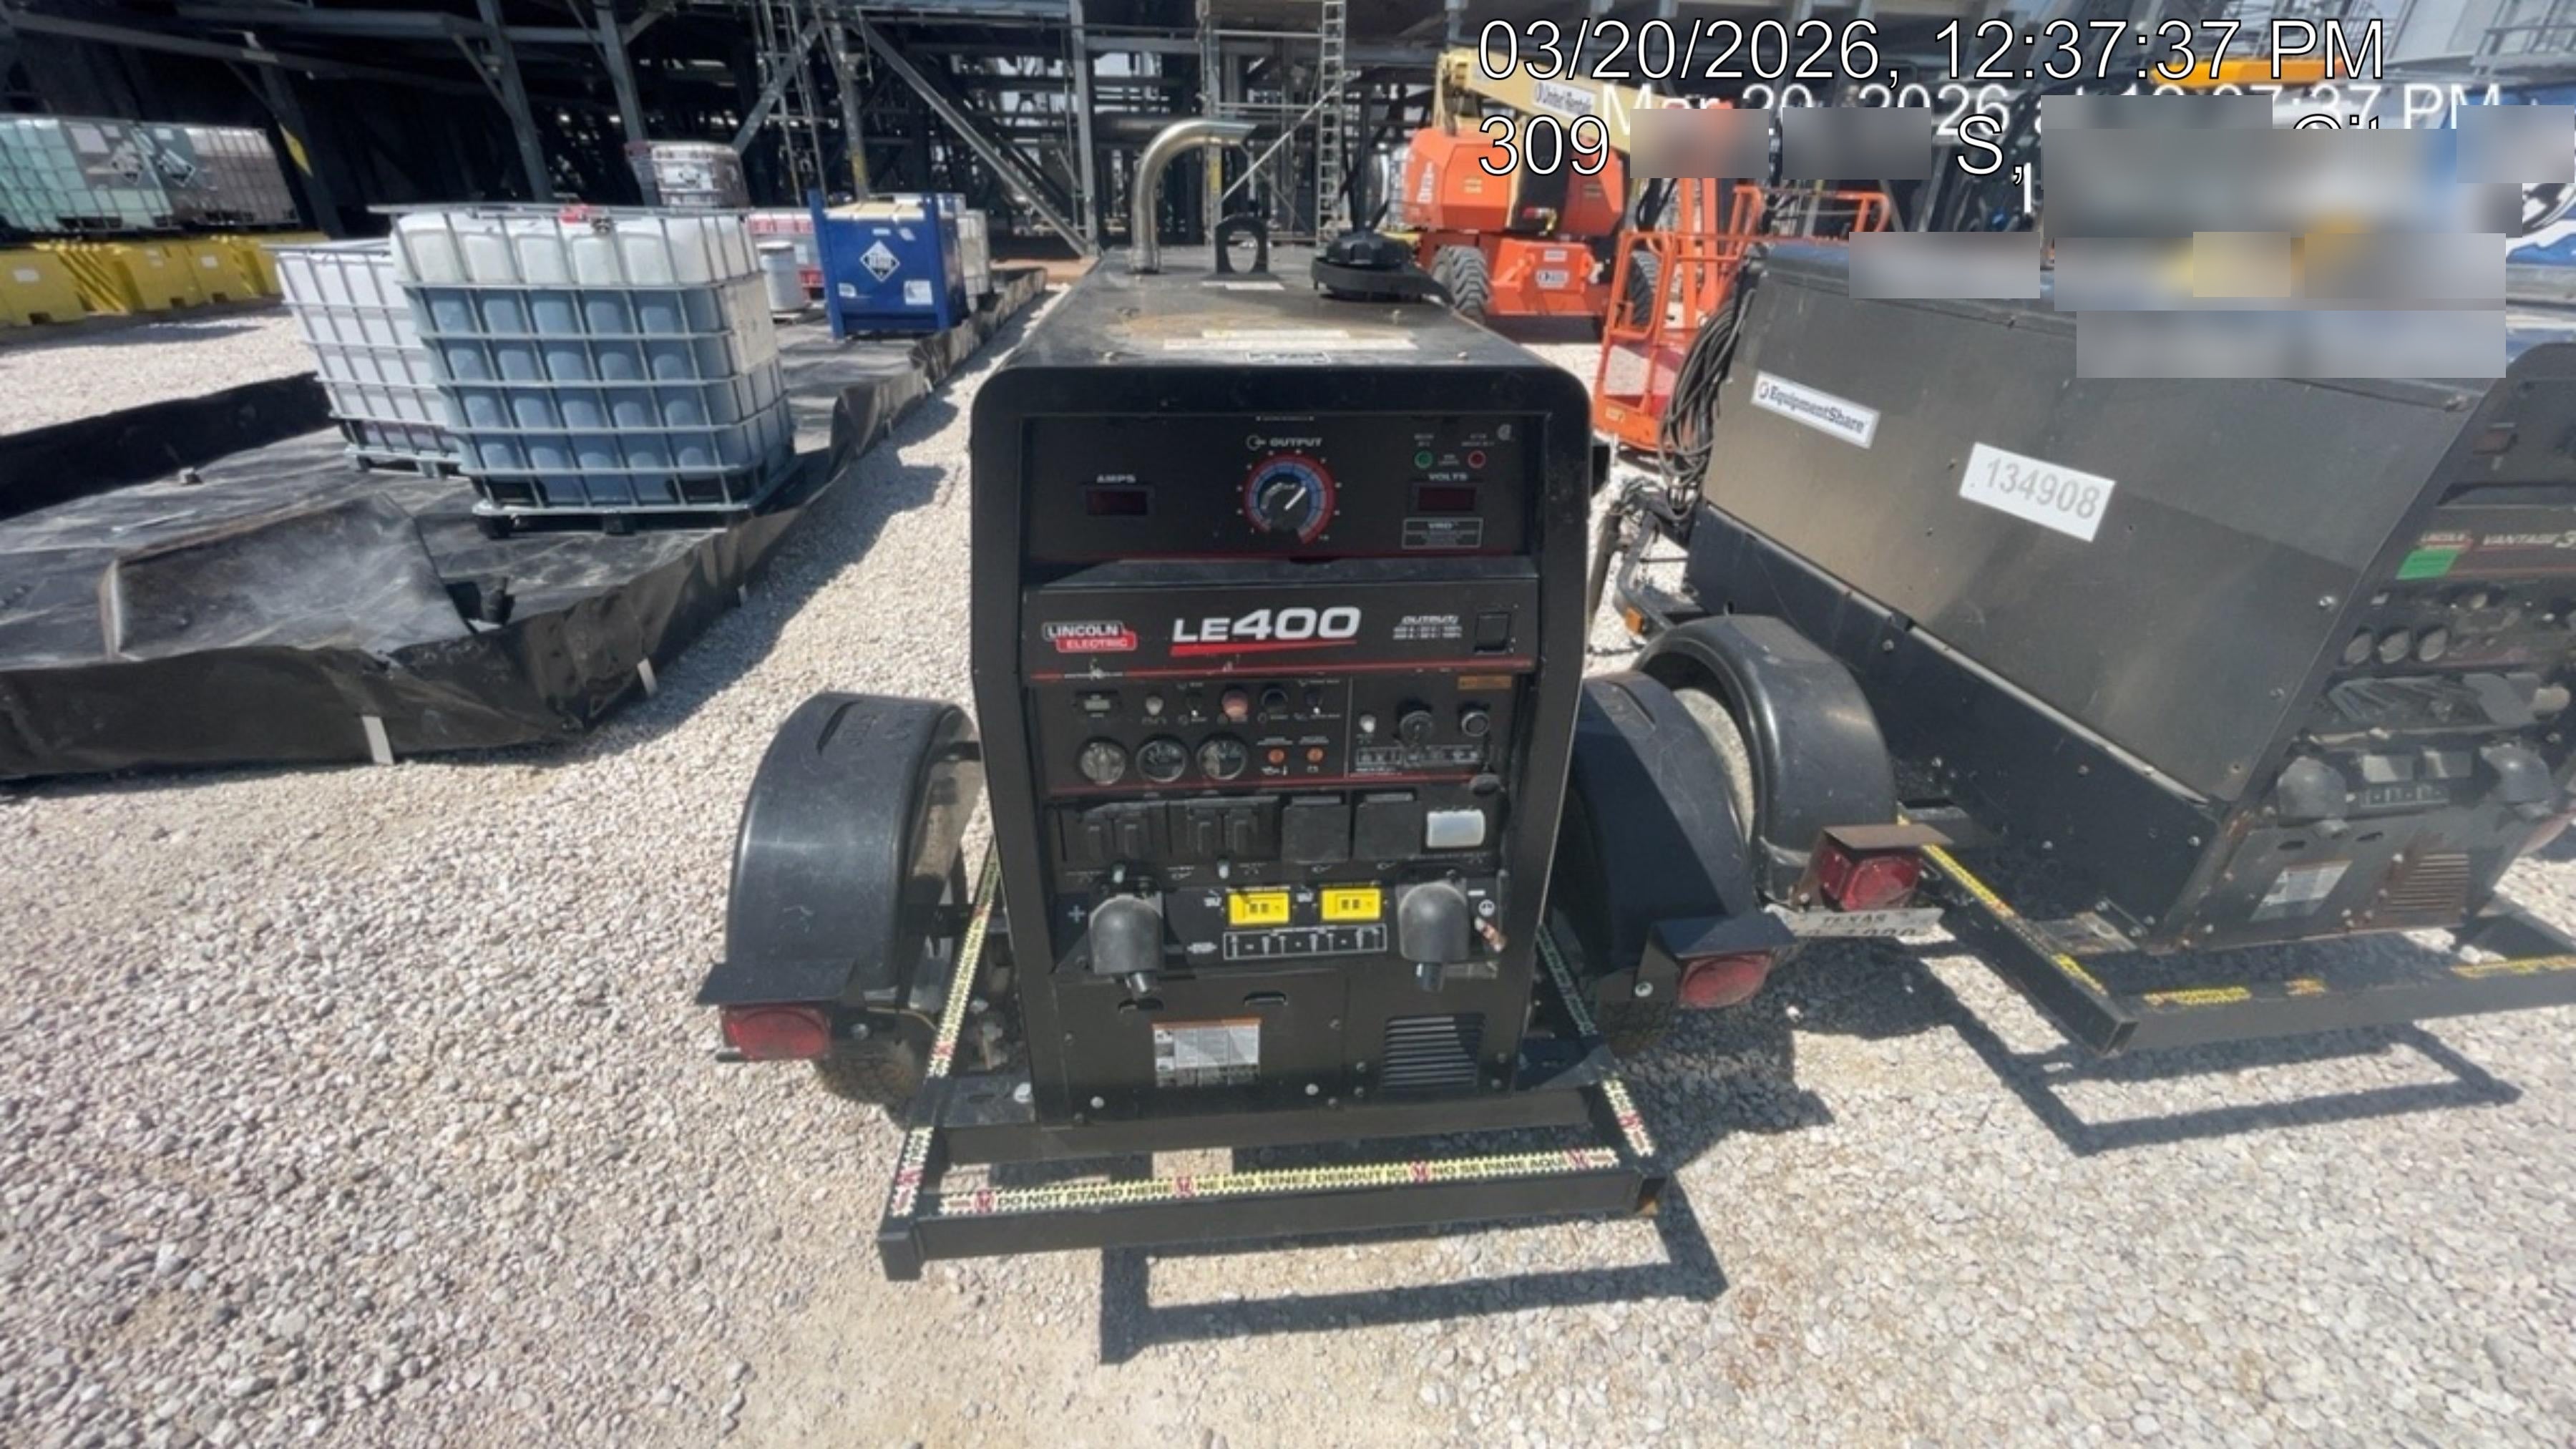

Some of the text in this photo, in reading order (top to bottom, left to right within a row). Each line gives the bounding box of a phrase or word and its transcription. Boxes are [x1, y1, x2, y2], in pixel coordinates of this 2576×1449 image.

[1986, 457, 2101, 519] 134908
[1047, 624, 1120, 637] LINCOLN
[1172, 606, 1361, 643] LE400
[1066, 638, 1128, 649] ELECTRIC
[997, 1184, 1171, 1207] DO NOT STAND HERE
